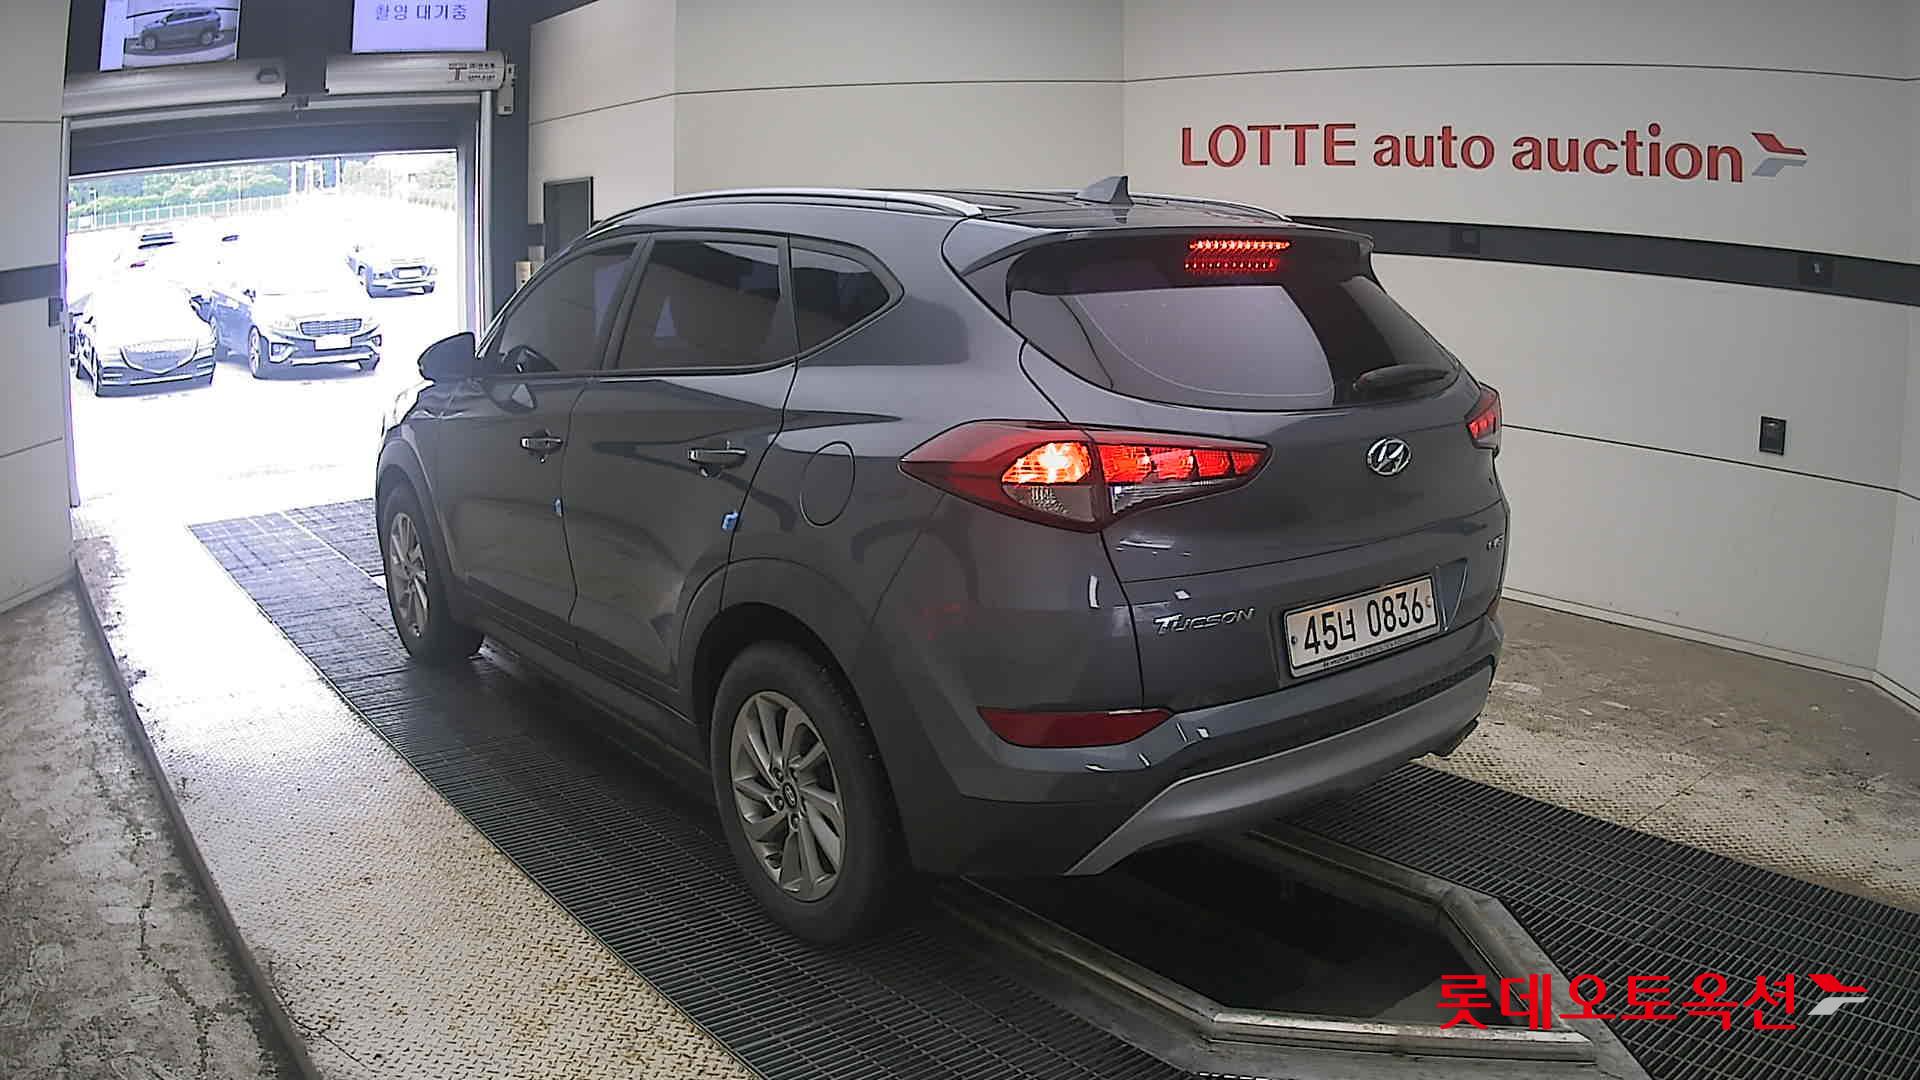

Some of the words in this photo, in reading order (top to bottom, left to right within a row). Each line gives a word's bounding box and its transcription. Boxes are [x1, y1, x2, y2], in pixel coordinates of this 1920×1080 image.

[416, 4, 466, 21] 대기중
[1181, 122, 1357, 168] LOTTE
[1373, 125, 1495, 169] auto
[1512, 123, 1743, 183] auction
[1153, 607, 1256, 636] TUCSON
[1303, 608, 1357, 655] 45너
[1366, 587, 1425, 637] 0836
